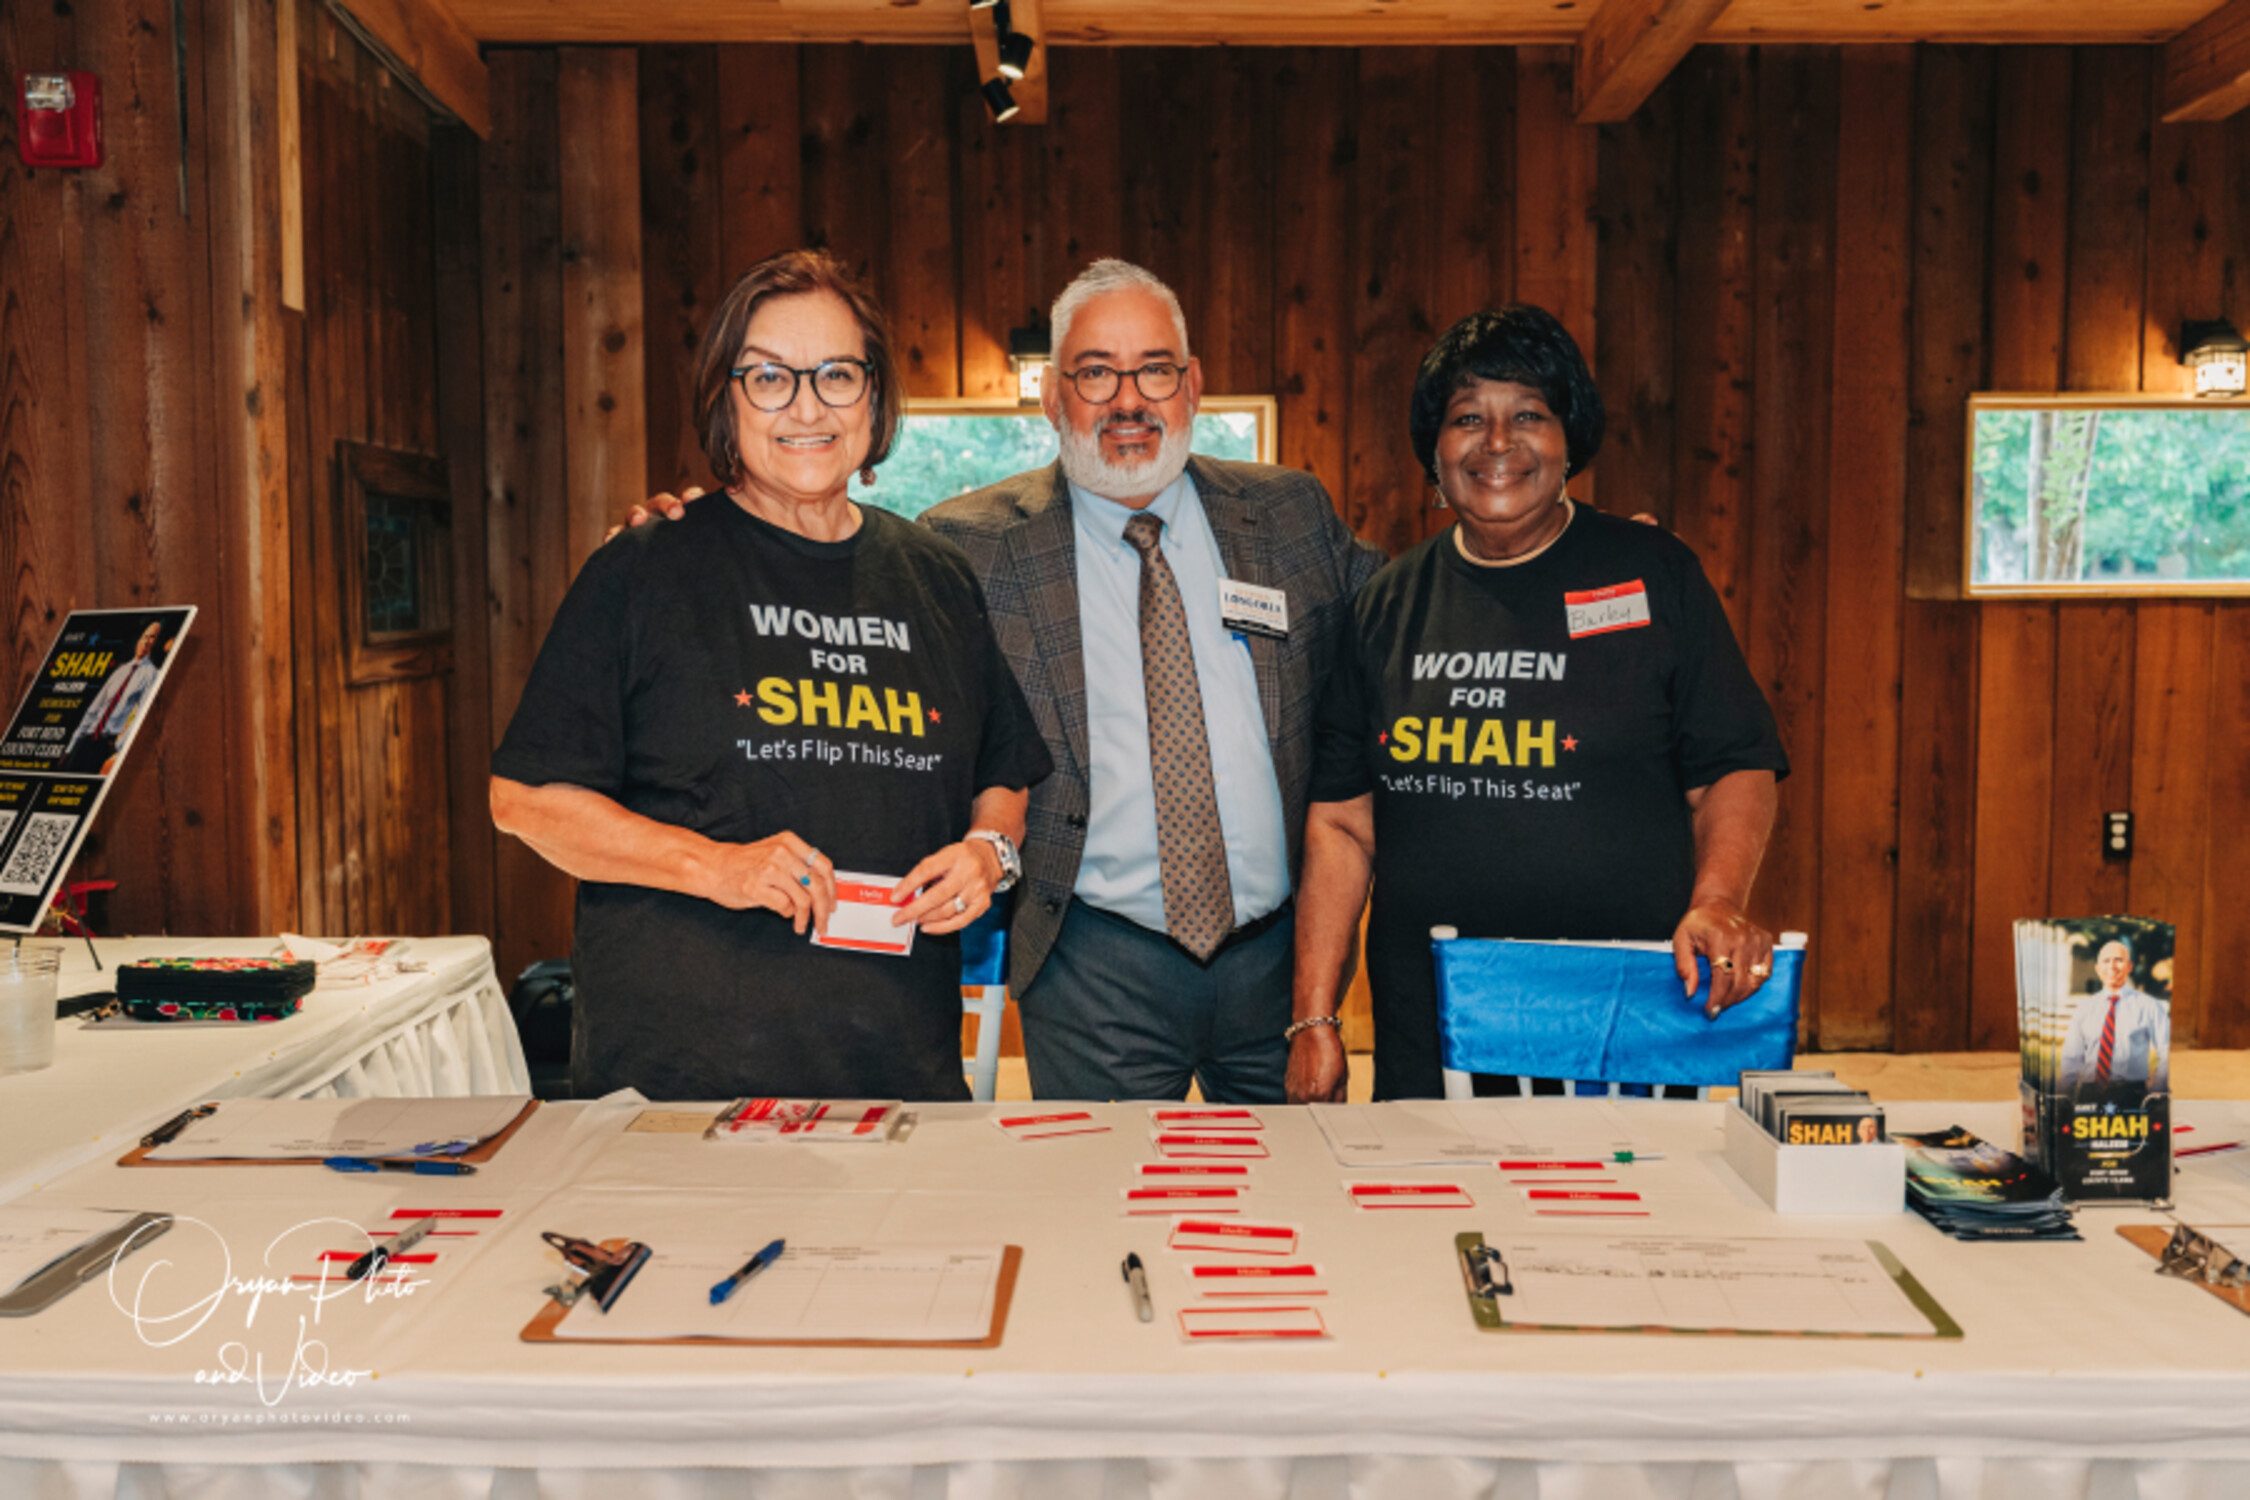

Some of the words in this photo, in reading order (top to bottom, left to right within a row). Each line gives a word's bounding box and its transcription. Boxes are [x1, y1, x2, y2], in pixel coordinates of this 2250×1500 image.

[750, 604, 911, 652] WOMEN
[50, 652, 113, 677] SHAH
[810, 648, 868, 675] FOR
[1412, 651, 1567, 681] WOMEN
[756, 676, 925, 738] SHAH
[1449, 687, 1507, 708] FOR
[801, 740, 844, 766] Flip
[847, 742, 891, 766] This
[1389, 716, 1556, 768] SHAH
[1426, 775, 1466, 798] Flip
[1470, 778, 1517, 799] This
[1789, 1123, 1853, 1145] SHAH
[2073, 1115, 2149, 1139] SHAH
